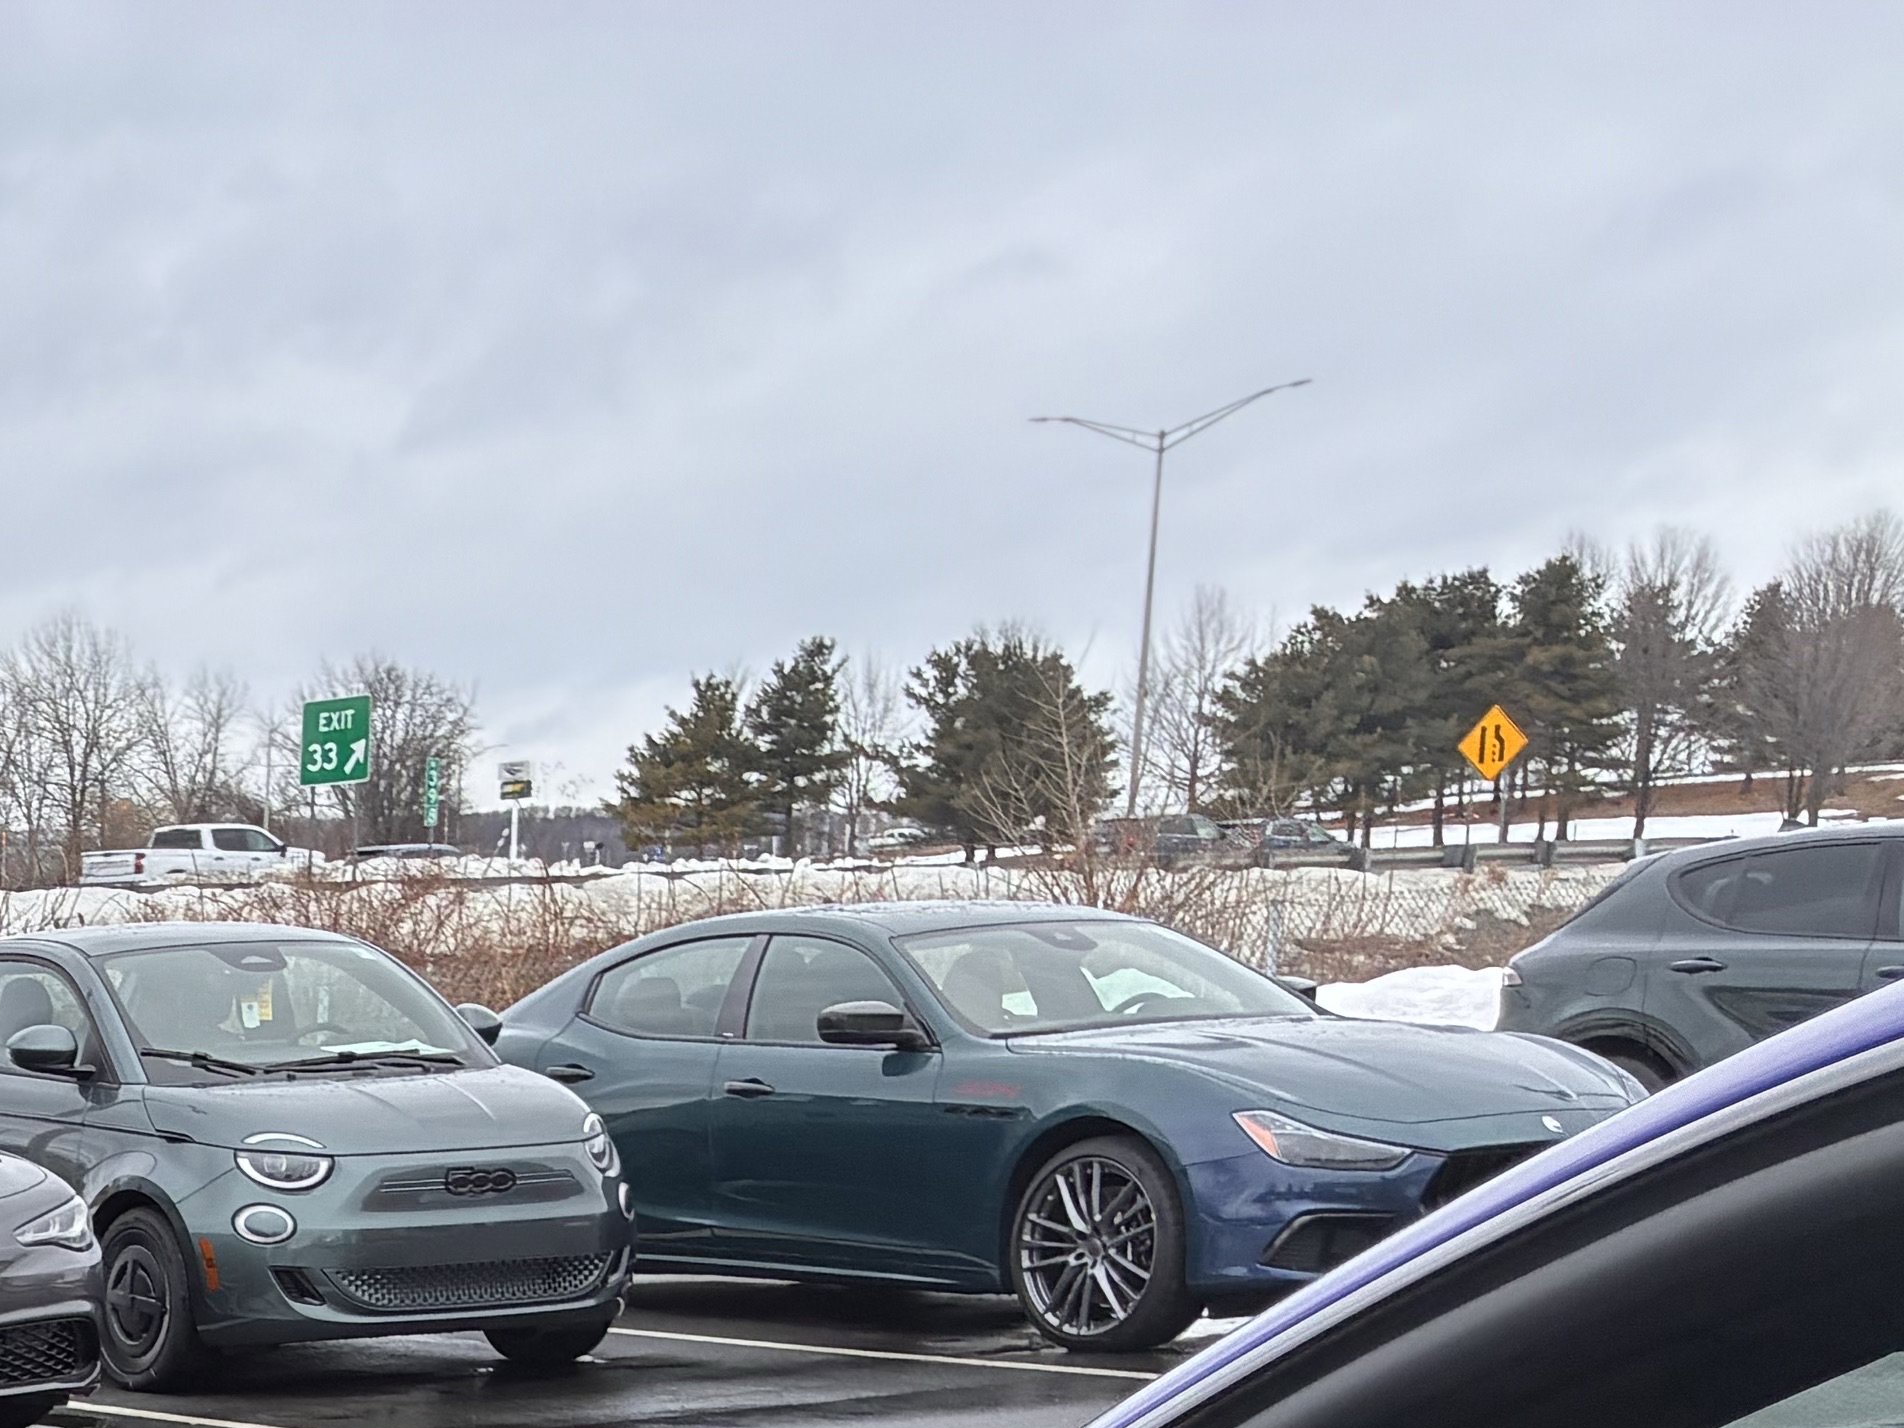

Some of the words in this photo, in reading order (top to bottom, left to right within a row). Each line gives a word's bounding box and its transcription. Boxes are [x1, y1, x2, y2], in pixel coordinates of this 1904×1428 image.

[318, 708, 355, 733] EXIT
[306, 741, 338, 773] 33
[445, 1166, 516, 1196] 500
